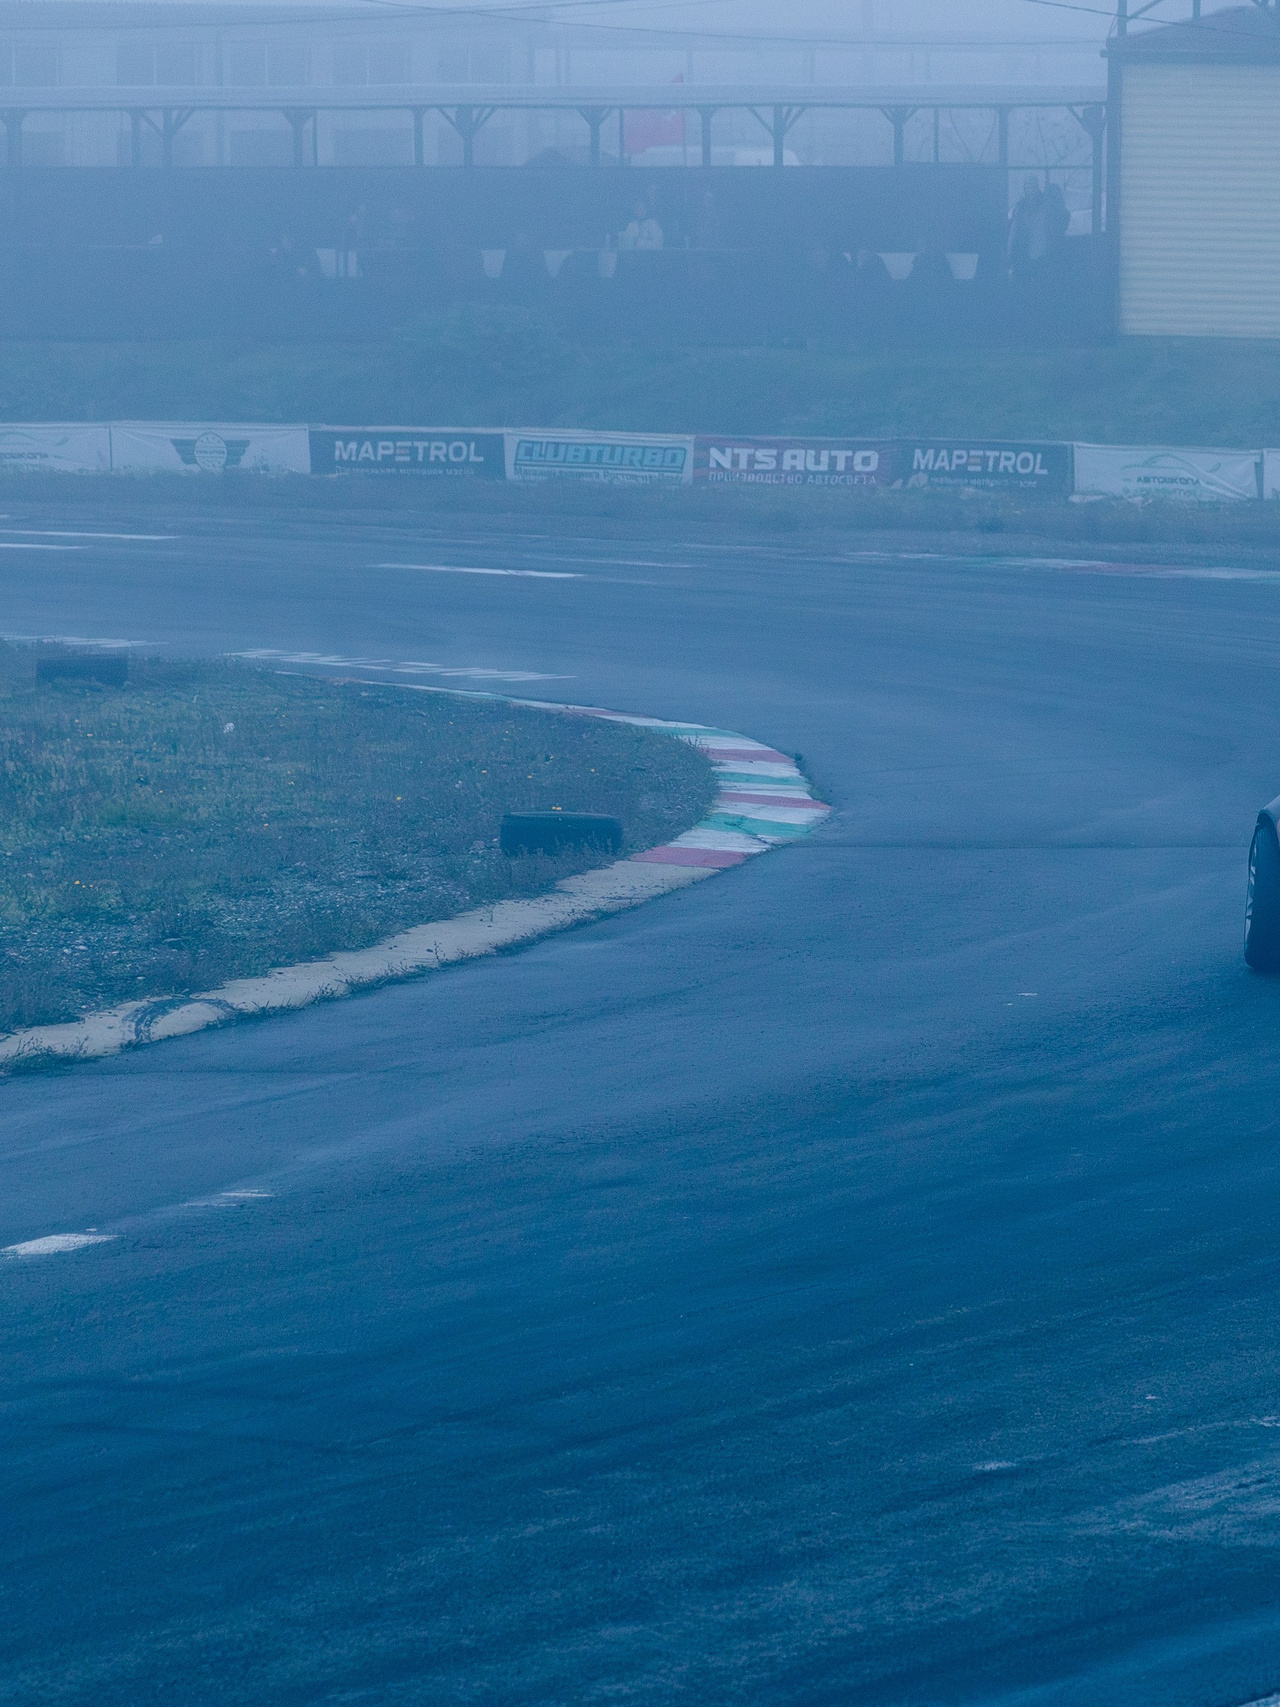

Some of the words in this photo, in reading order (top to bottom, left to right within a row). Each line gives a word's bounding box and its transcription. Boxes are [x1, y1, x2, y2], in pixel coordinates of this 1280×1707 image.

[334, 441, 484, 462] MAPETROL
[516, 442, 686, 469] CLUBTURBO
[709, 447, 778, 470] NTS
[783, 449, 879, 472] AUTO
[912, 449, 1049, 475] MAPETROL
